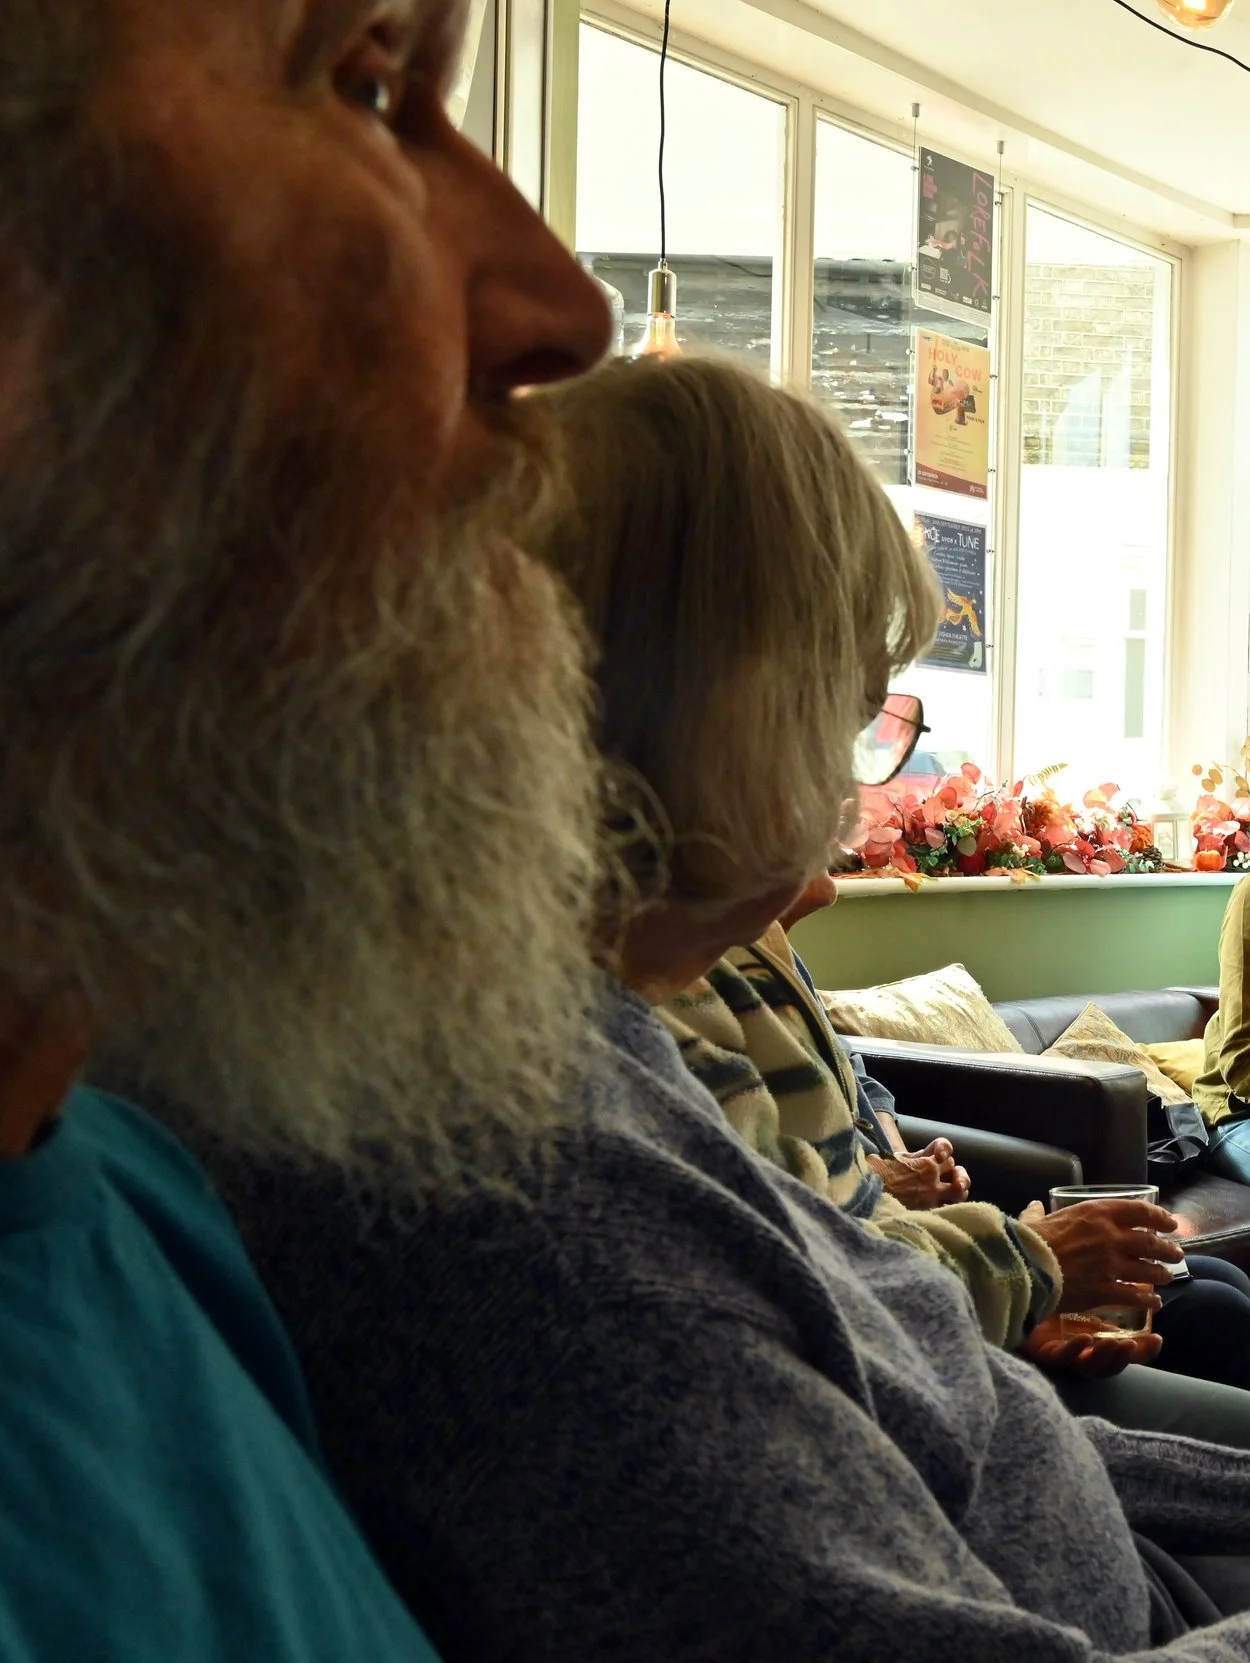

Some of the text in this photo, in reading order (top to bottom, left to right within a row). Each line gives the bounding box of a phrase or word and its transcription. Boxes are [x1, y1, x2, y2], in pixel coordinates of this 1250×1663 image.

[928, 347, 959, 366] HOLY
[955, 364, 982, 381] COW
[957, 532, 980, 550] TUNE
